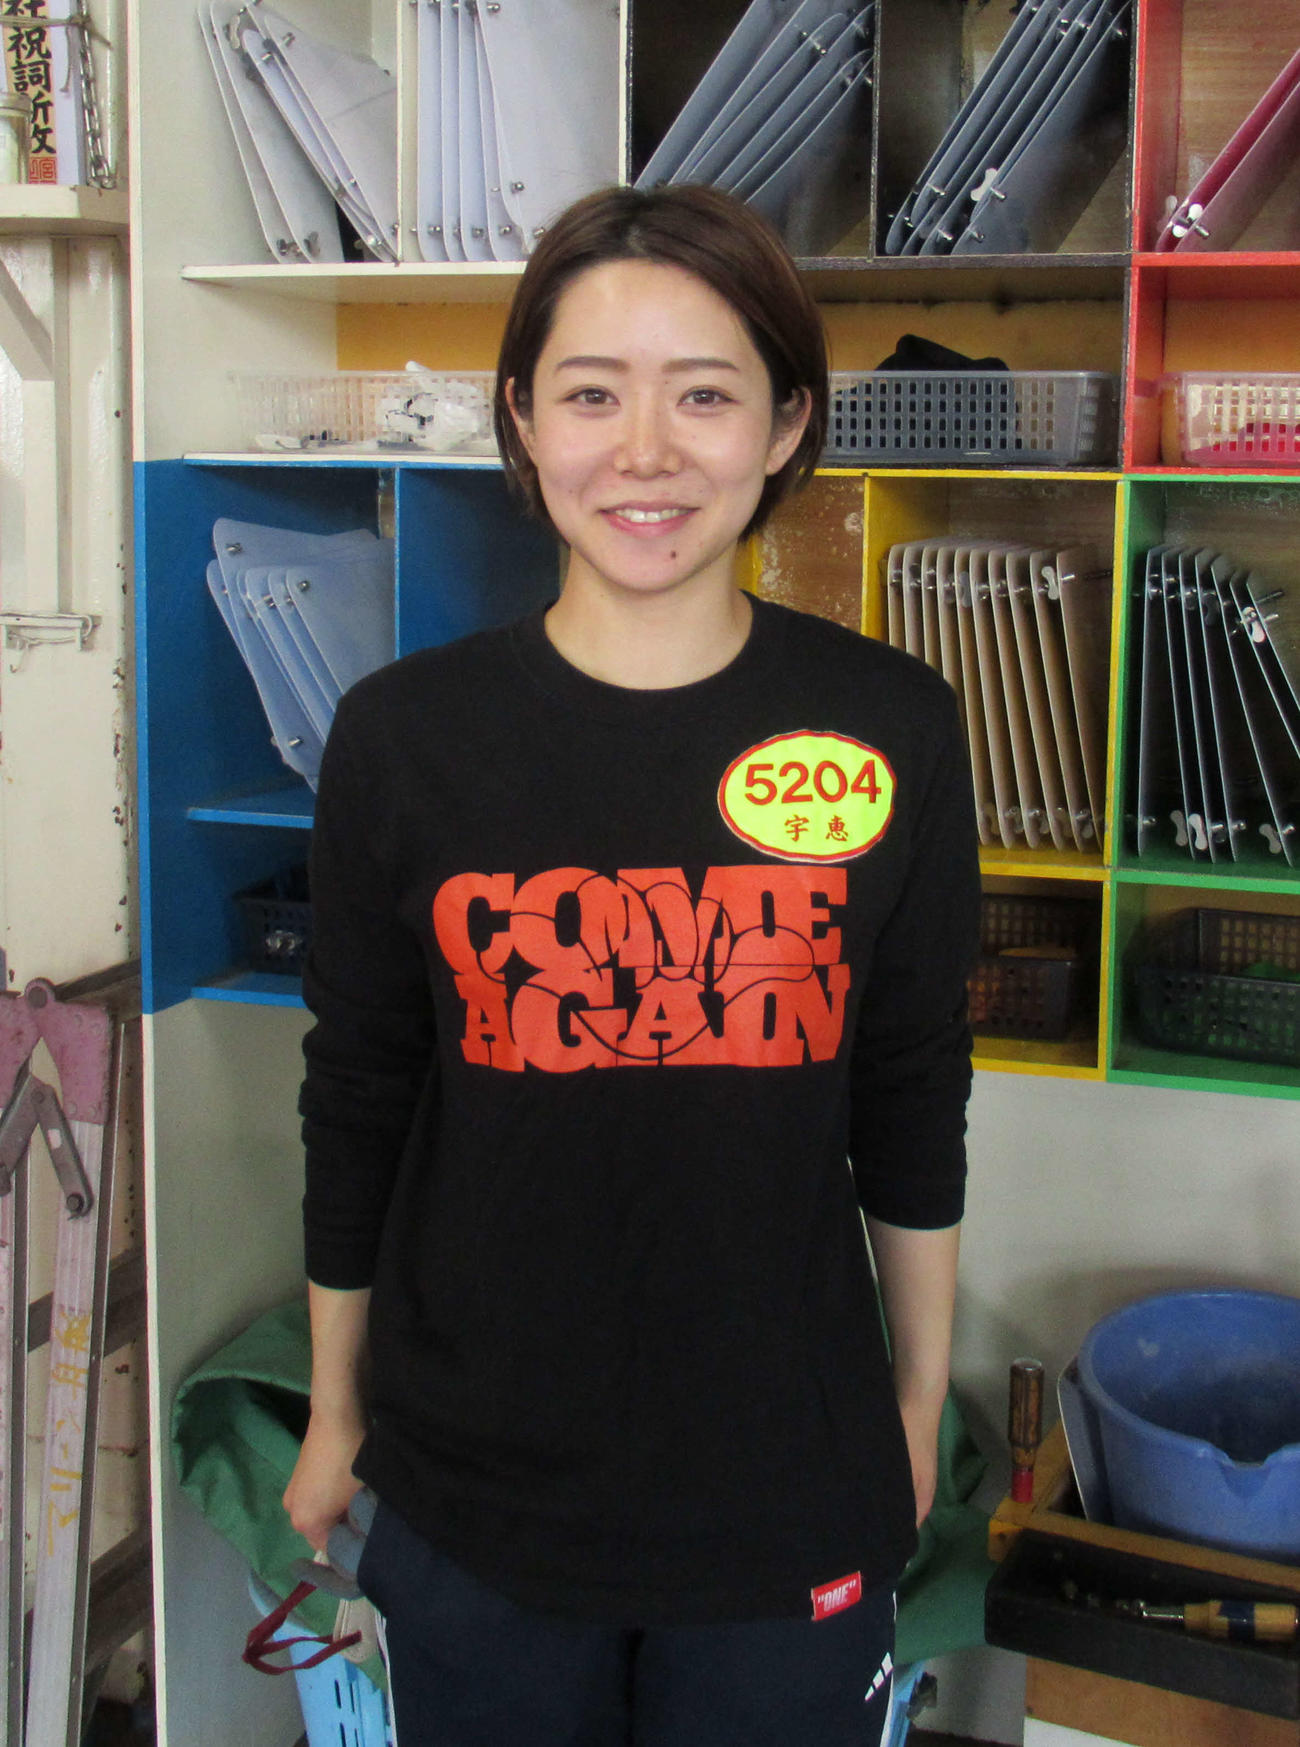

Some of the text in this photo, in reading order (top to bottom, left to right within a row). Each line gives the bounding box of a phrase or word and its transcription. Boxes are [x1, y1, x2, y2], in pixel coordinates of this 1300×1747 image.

[744, 759, 882, 806] 5204
[433, 865, 847, 975] COME
[454, 964, 850, 1072] AGAIN
